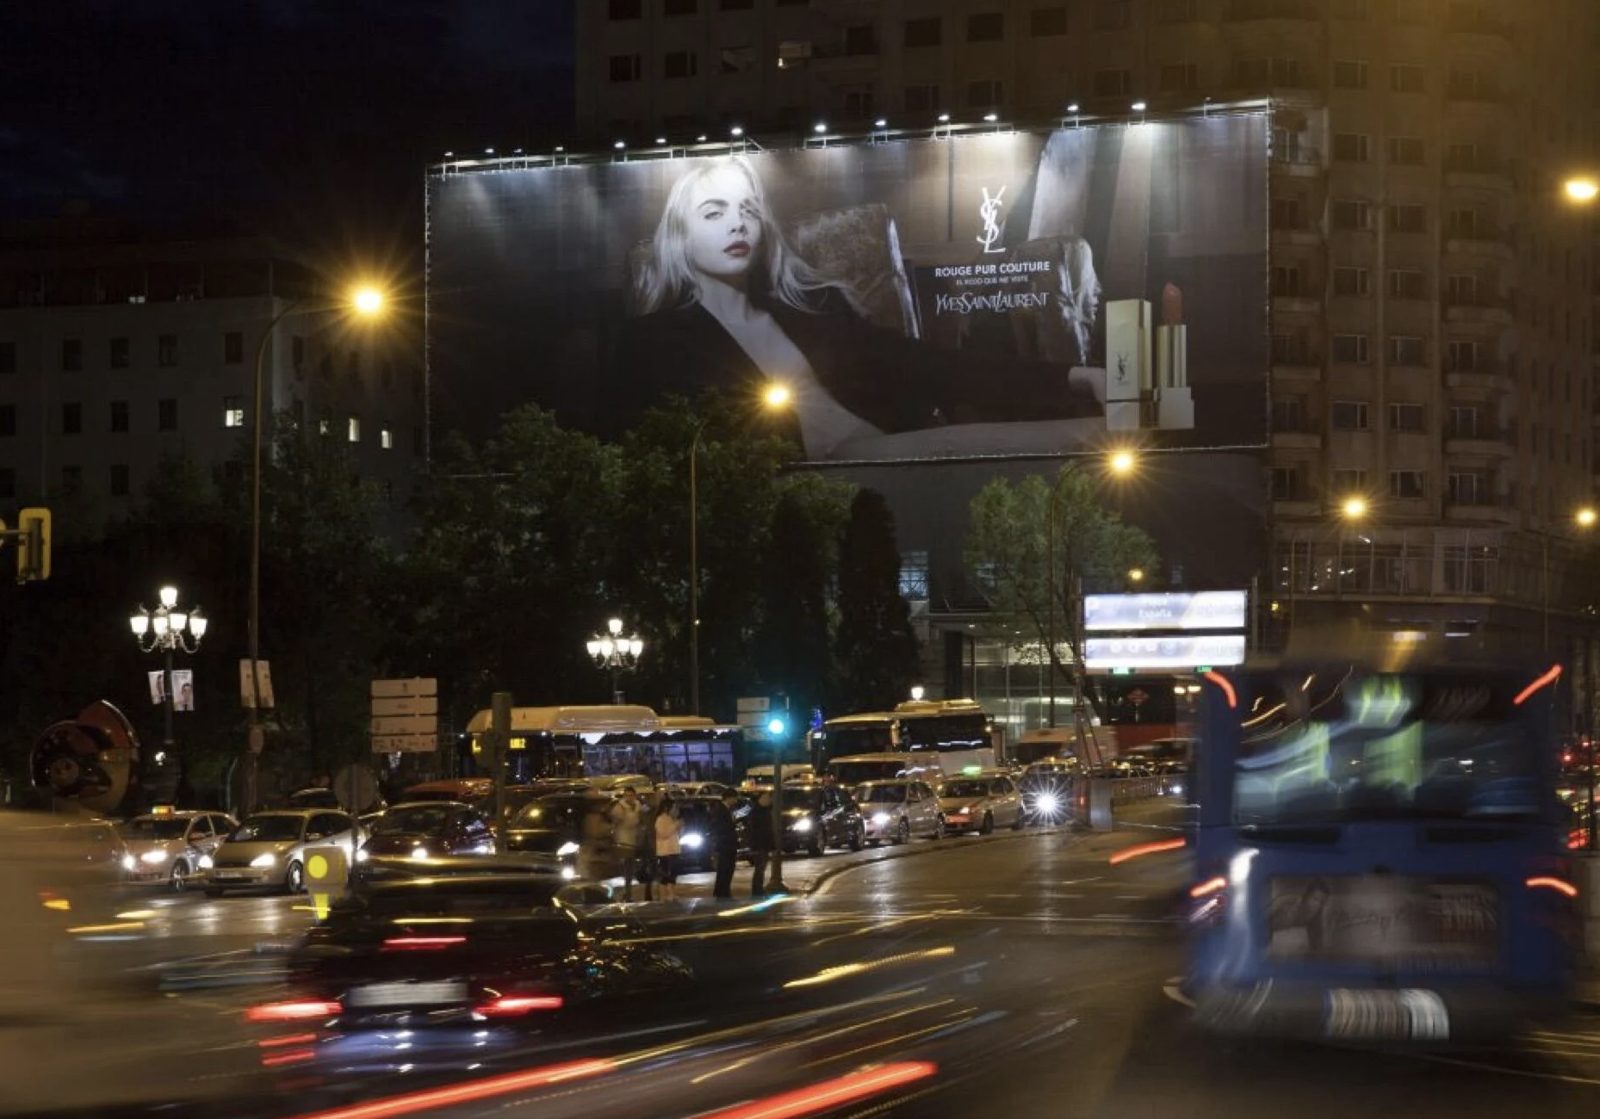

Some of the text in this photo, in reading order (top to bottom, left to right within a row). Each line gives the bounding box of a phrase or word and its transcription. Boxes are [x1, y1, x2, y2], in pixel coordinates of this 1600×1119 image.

[935, 261, 1050, 277] ROUGE PUR COUTURE
